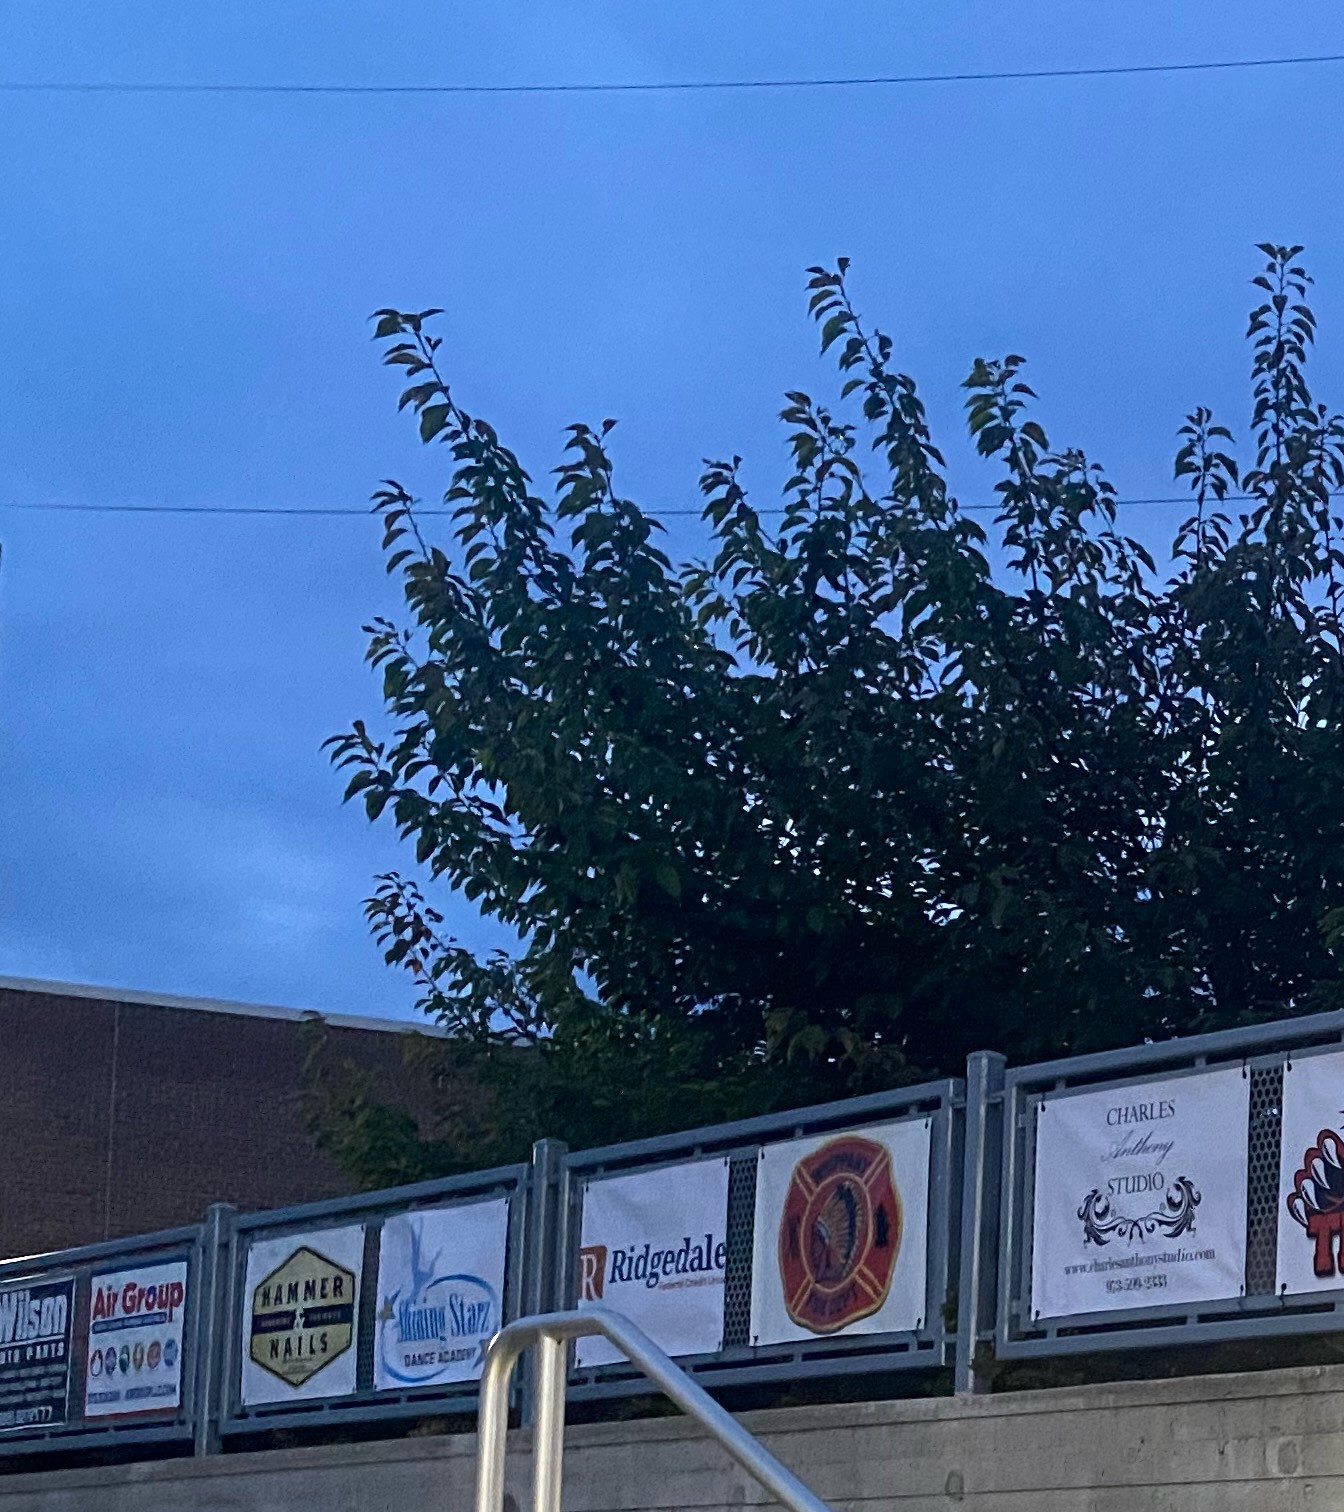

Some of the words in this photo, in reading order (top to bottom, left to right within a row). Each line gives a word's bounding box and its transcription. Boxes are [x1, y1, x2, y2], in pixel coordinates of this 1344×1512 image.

[1107, 1100, 1175, 1126] CHARLES
[1101, 1129, 1175, 1165] Anthony
[1107, 1172, 1165, 1196] STUDIO
[608, 1234, 726, 1289] Ridgedale
[93, 1285, 118, 1320] Air
[121, 1282, 183, 1323] Group
[261, 1275, 344, 1307] HAMMER
[449, 1293, 490, 1337] Starz
[270, 1332, 328, 1359] NAILS
[404, 1352, 436, 1367] DANCE
[438, 1347, 477, 1364] ACADEMY
